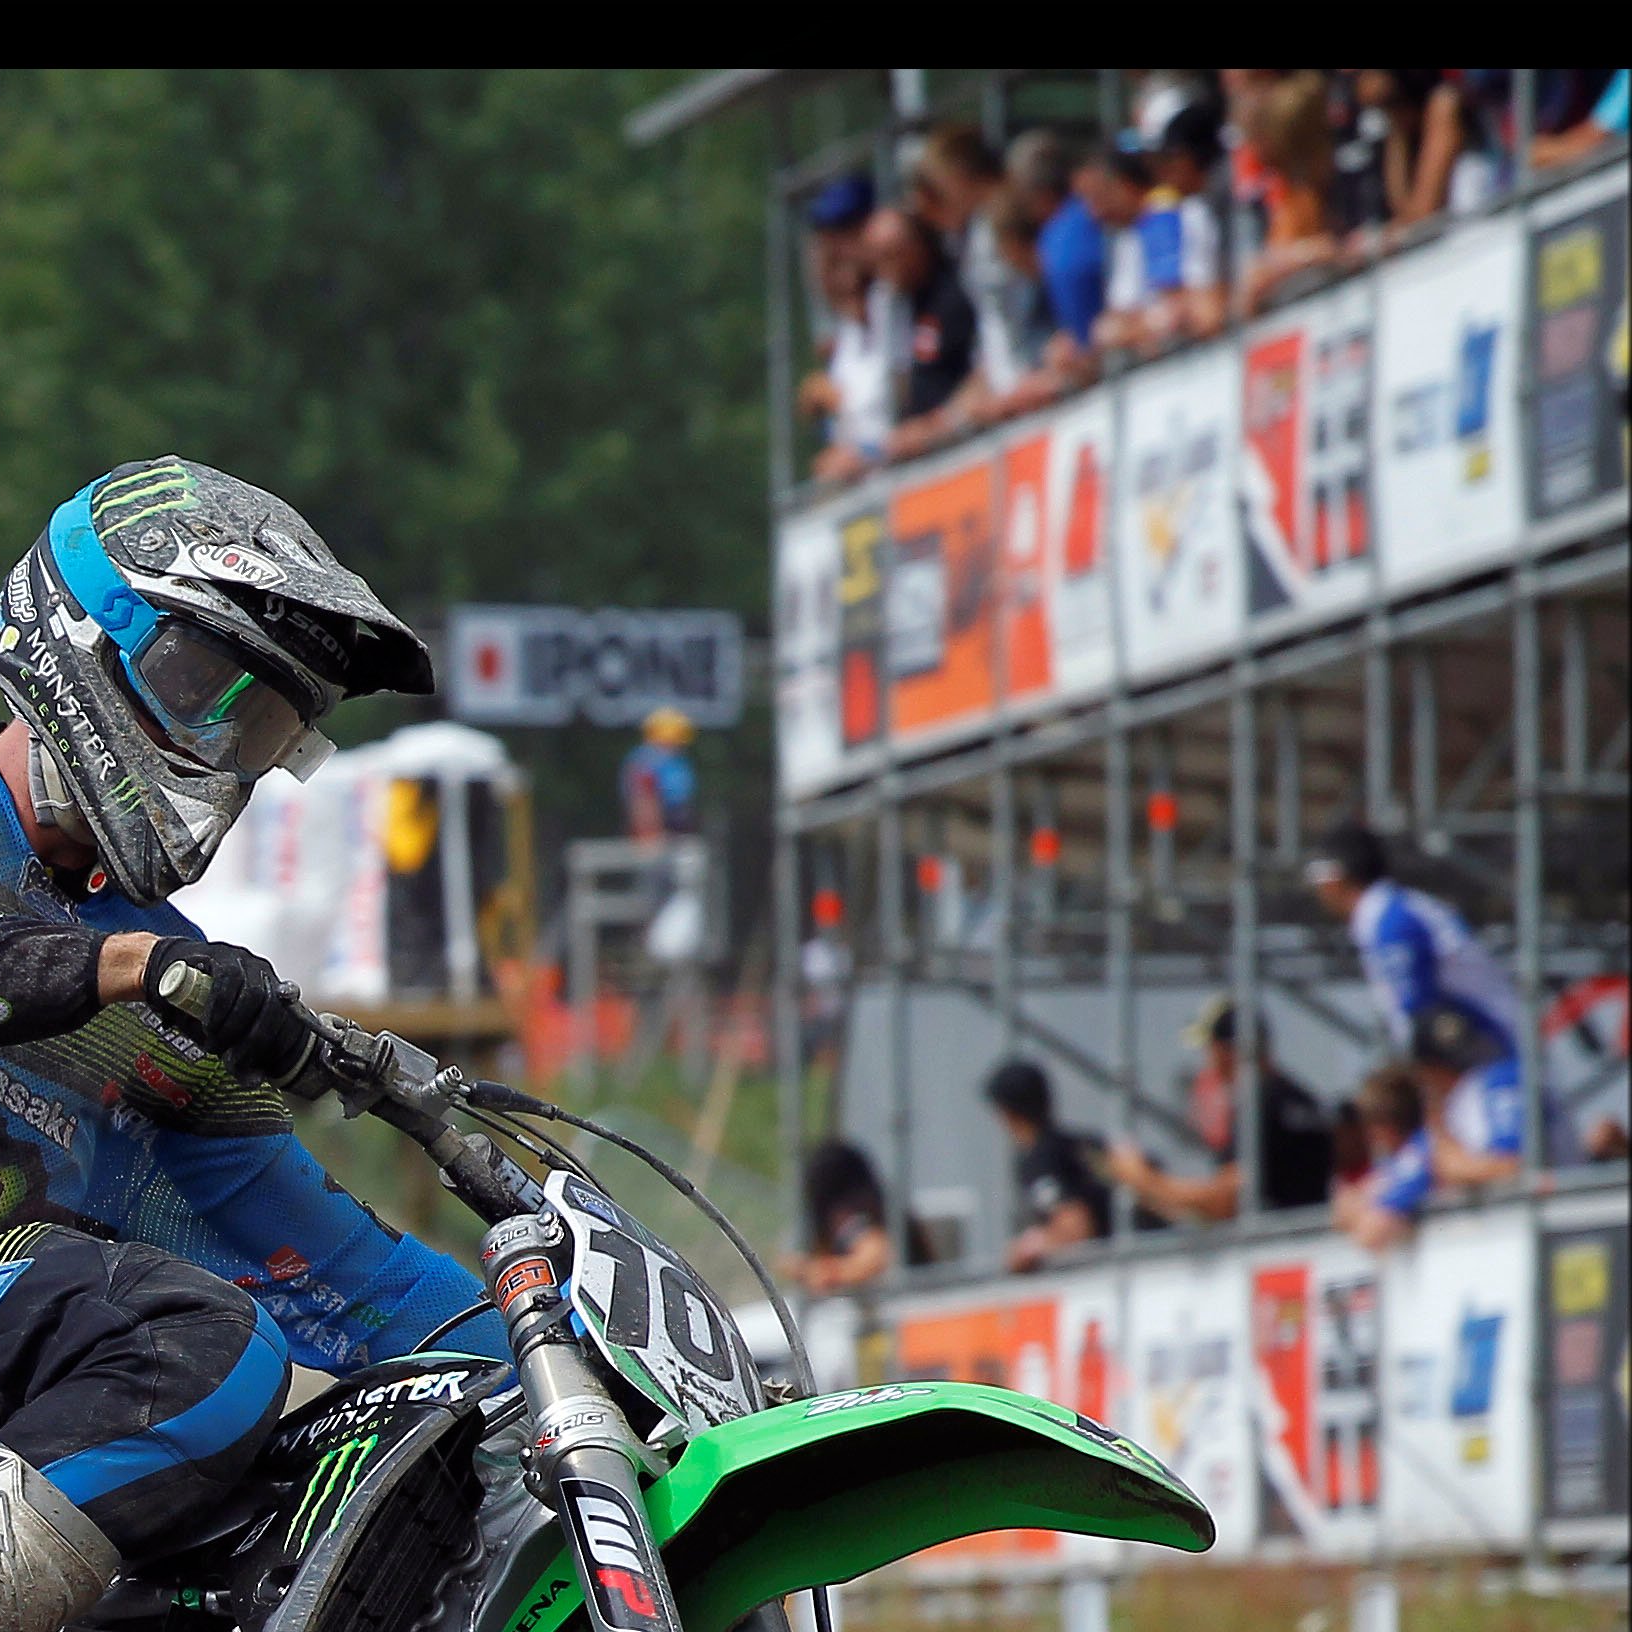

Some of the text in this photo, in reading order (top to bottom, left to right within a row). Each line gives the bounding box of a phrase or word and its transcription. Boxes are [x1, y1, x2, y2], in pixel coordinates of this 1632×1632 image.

[199, 543, 273, 587] SUOMY
[19, 667, 80, 768] ENERGY
[26, 627, 117, 781] MONSTER
